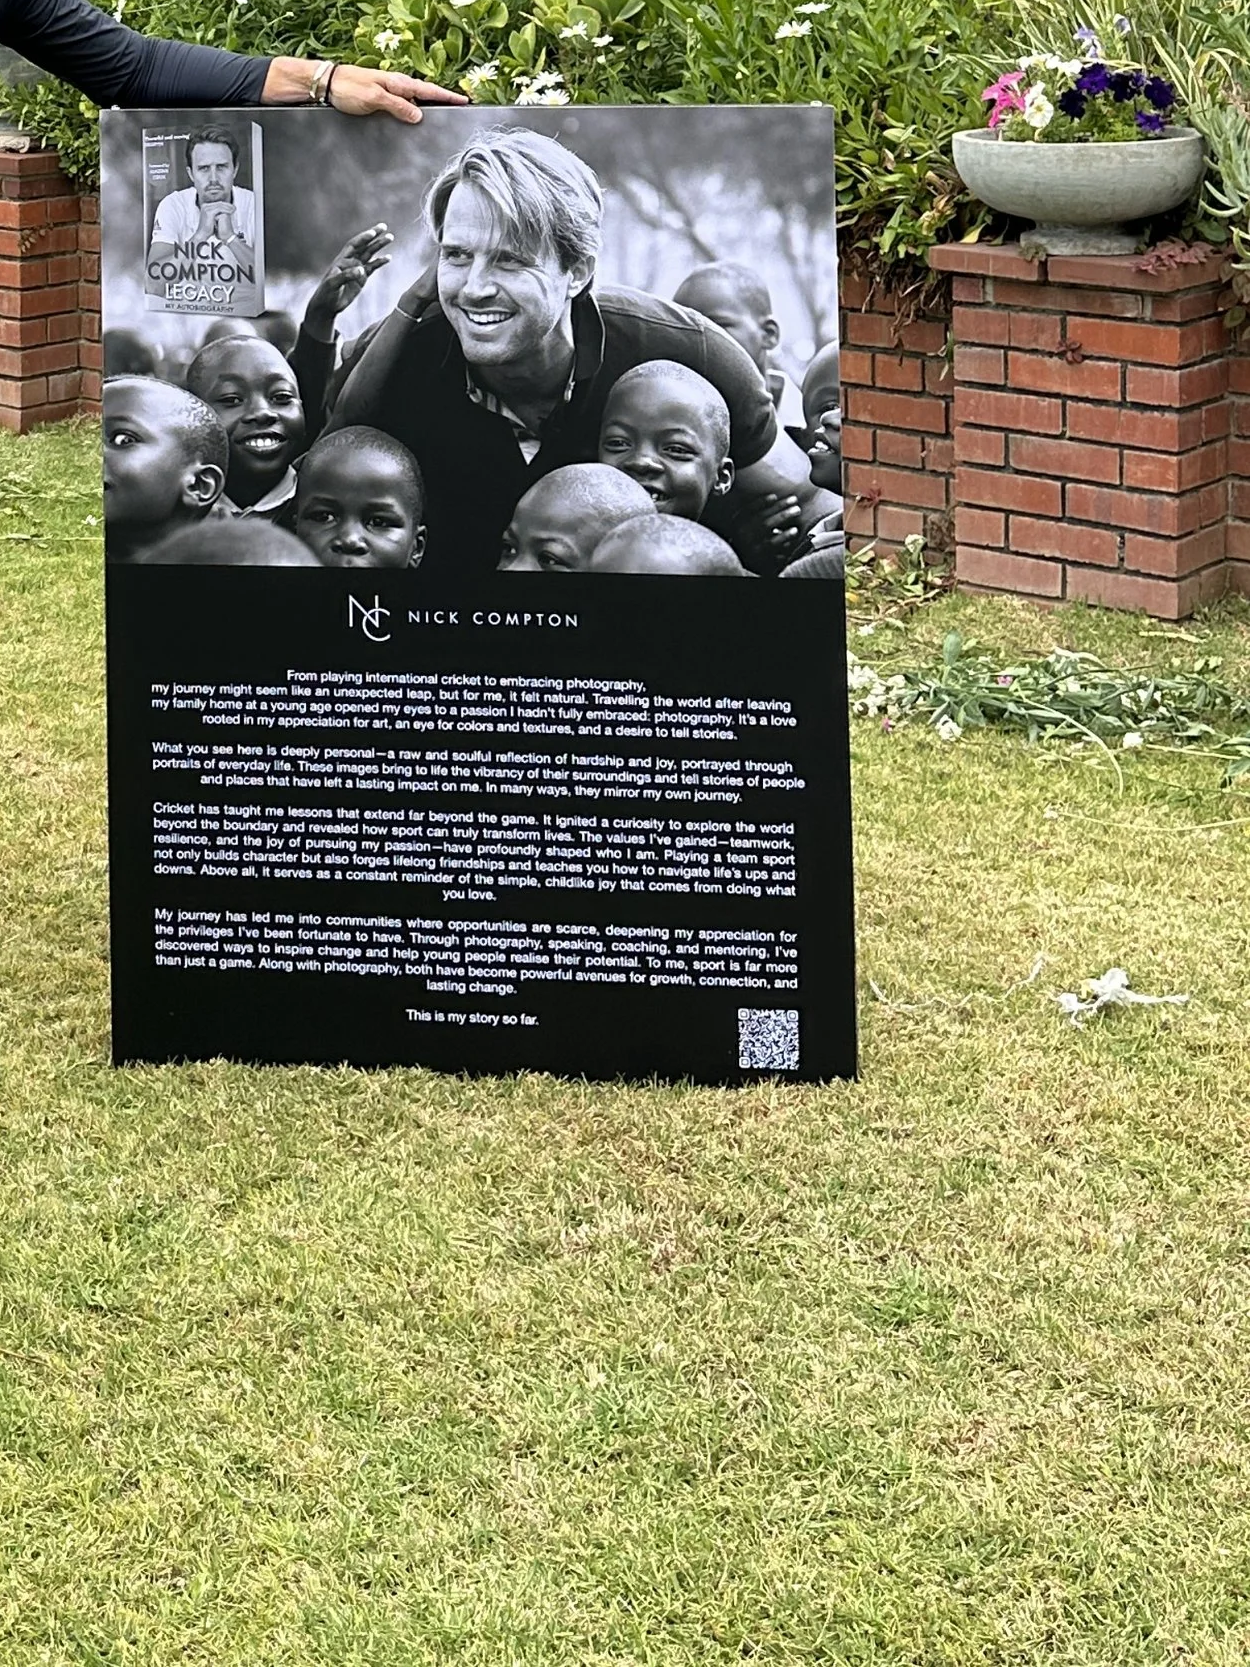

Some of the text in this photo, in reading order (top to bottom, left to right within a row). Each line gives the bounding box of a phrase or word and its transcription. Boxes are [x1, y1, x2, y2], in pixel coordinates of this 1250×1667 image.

[174, 241, 224, 260] NICK
[148, 261, 255, 284] COMPTON
[165, 283, 235, 303] LEGACY
[408, 610, 578, 627] NICK COMPTON
[286, 670, 645, 693] From playing international cricket to embracing photography,
[151, 682, 791, 712] my journey might seem like an unexpected leap, but for me, it felt natural. Travelling the world after leaving
[202, 713, 737, 739] rooted in my appreciation for art, an eye for colors and textures, and a desire to tell stories.
[200, 773, 742, 803] and places that have left a lasting impact on me. In many ways, they mirror my own journey.
[152, 802, 794, 834] Cricket has taught me lessons that extend far beyond the game. It ignited a curiosity to explore the world
[153, 848, 795, 881] not only builds character but also forges lifelong friendships and teaches you how to navigate life's ups and
[442, 889, 496, 901] you love.
[154, 908, 797, 943] My journey has led me into communities where opportunities are scarce, deepening my appreciation for
[154, 924, 797, 958] the privileges I've been fortunate to have. Through photography, speaking, coaching, and mentoring, I've
[426, 979, 517, 996] lasting change.
[406, 1009, 538, 1025] This is my story so far.
